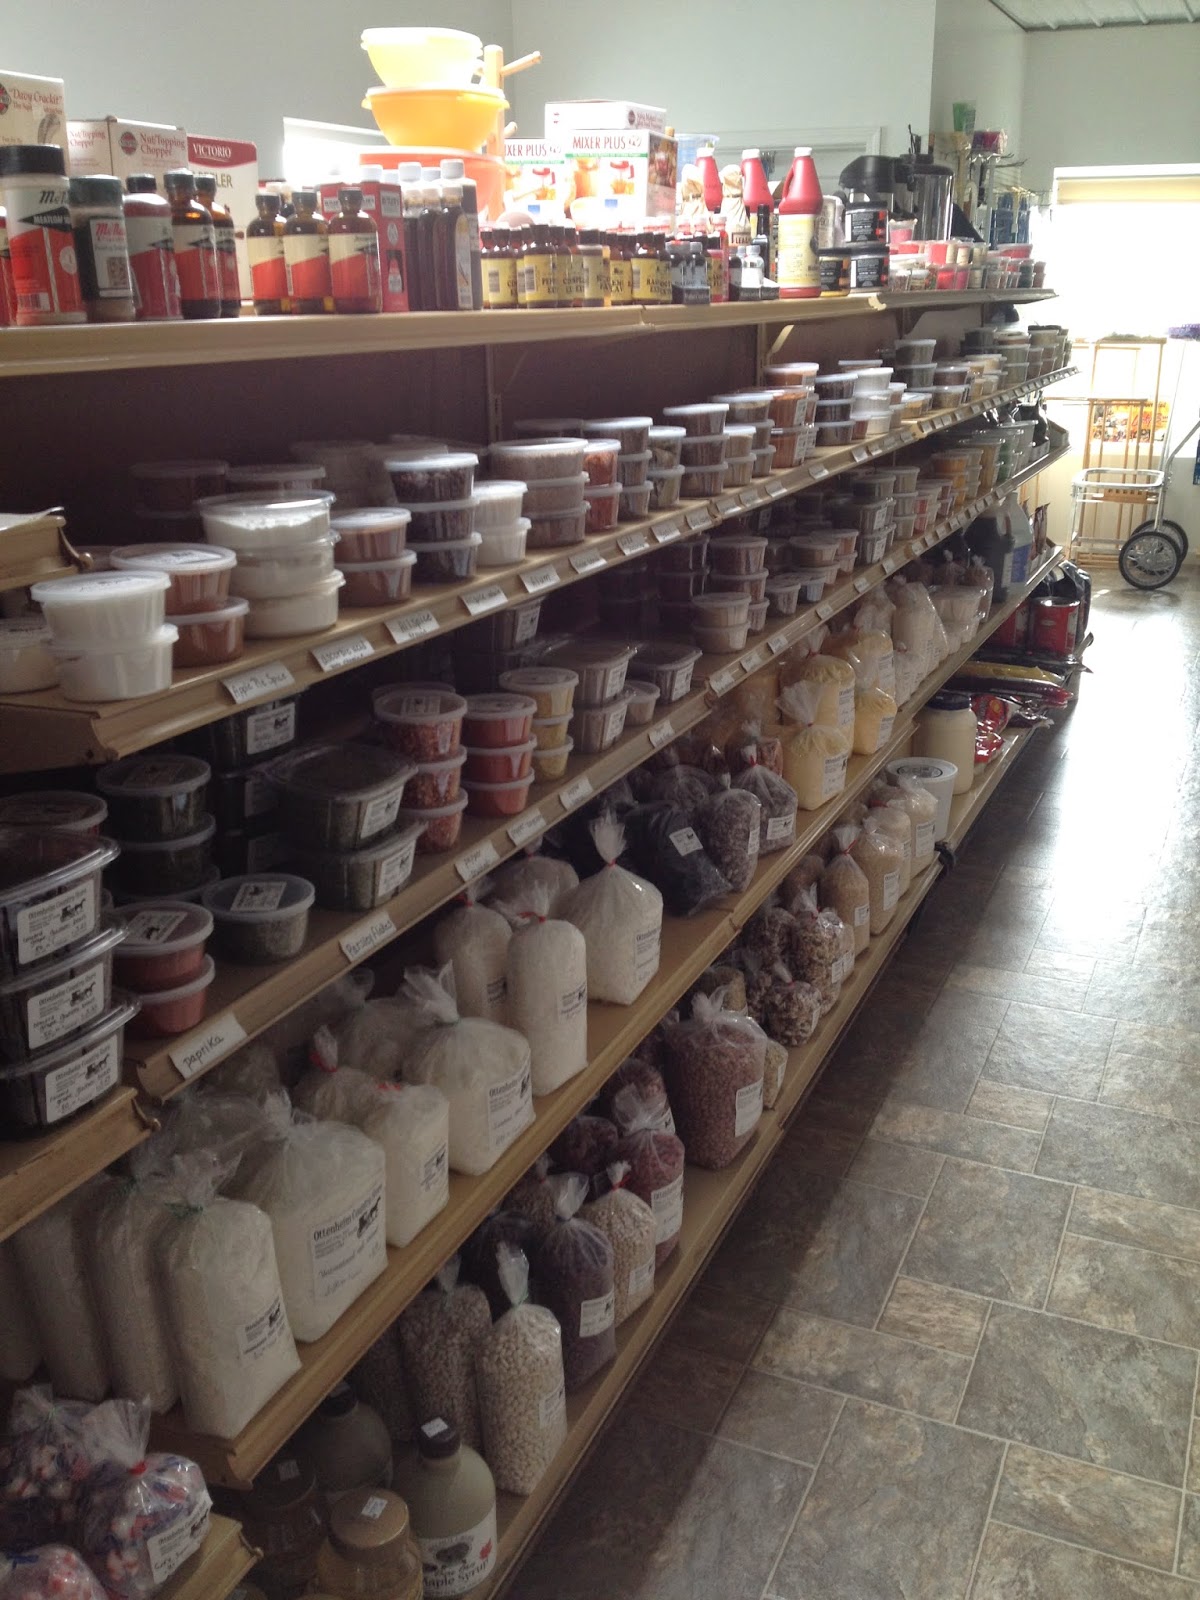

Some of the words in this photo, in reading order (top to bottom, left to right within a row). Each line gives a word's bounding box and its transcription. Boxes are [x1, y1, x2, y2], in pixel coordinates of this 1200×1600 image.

[572, 135, 601, 150] MIXER
[604, 135, 626, 150] PLUS
[193, 143, 231, 158] VICTORIO
[505, 144, 523, 157] IXER
[525, 144, 547, 157] PLUS
[265, 672, 287, 688] Spice
